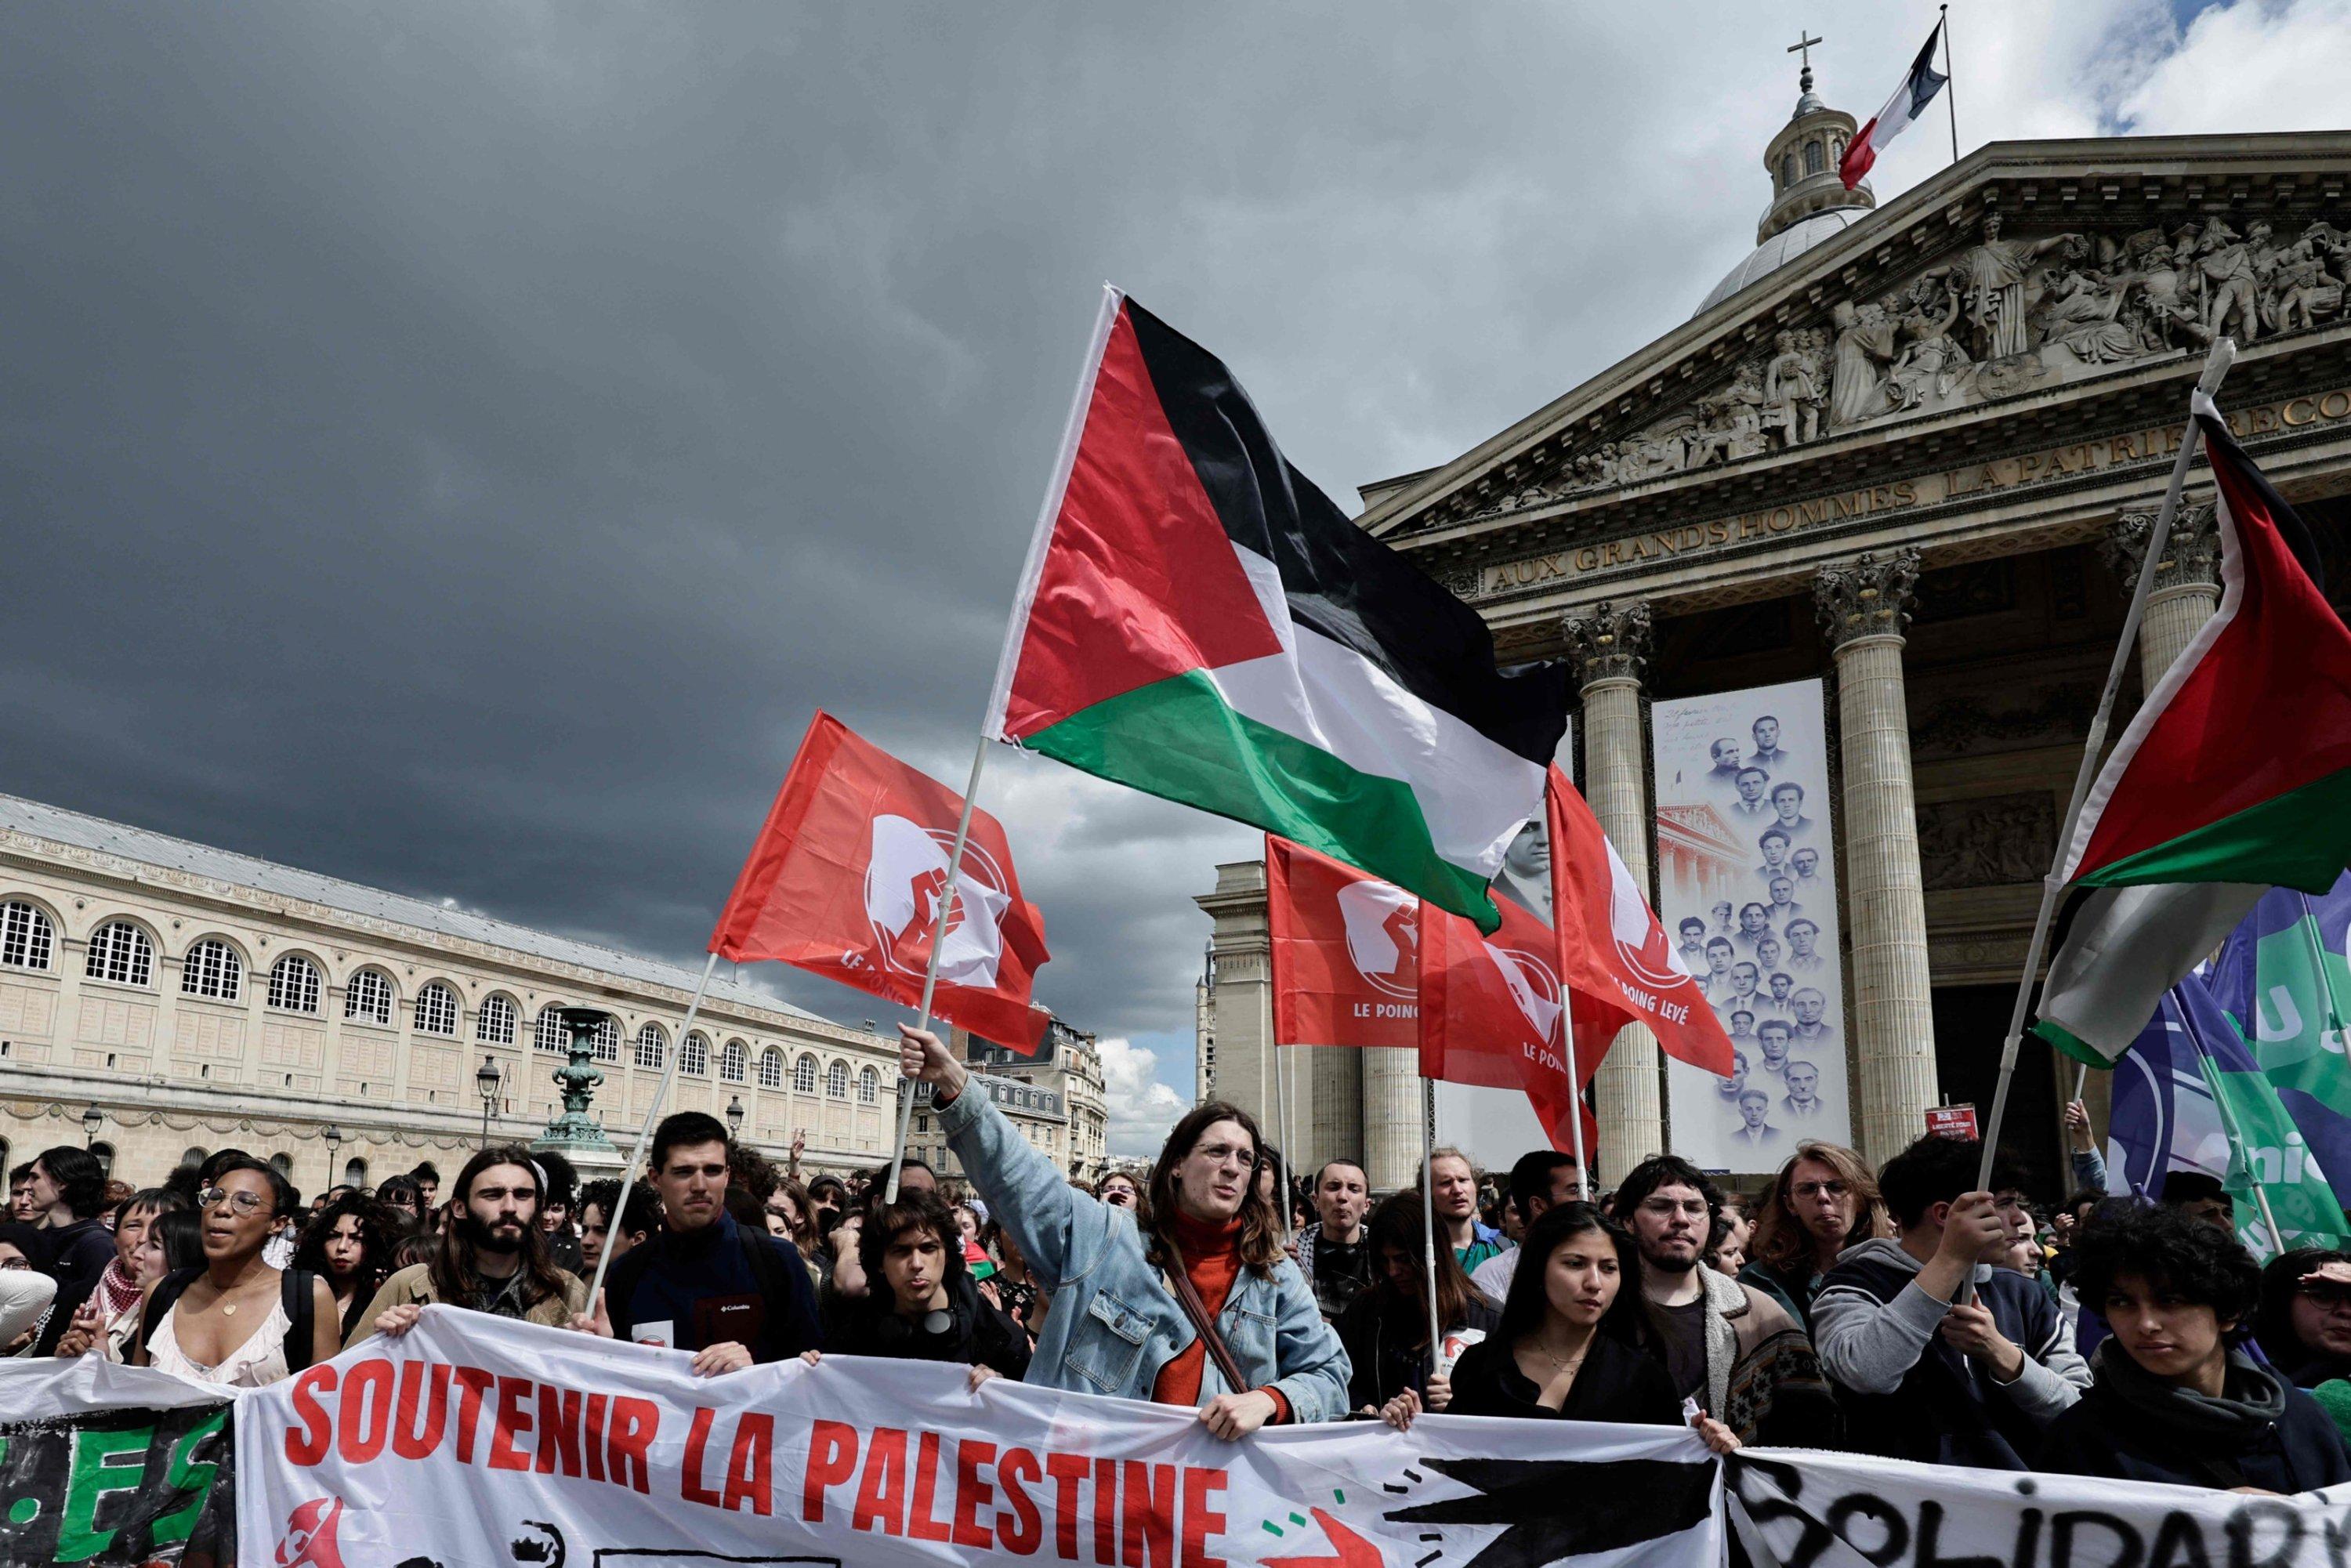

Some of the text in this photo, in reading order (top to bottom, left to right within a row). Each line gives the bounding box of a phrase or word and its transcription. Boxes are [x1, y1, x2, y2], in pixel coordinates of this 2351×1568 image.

[1492, 553, 1566, 588] AUX
[1575, 520, 1730, 571] GRANDS
[1737, 482, 1918, 539] HOMMES
[1943, 465, 2005, 498] LA
[1354, 1003, 1371, 1018] LE
[1621, 981, 1690, 1026] POING LEVÉ
[1523, 1041, 1536, 1061] LE
[284, 1358, 1228, 1568] SOUTENIR LA PALESTINE
